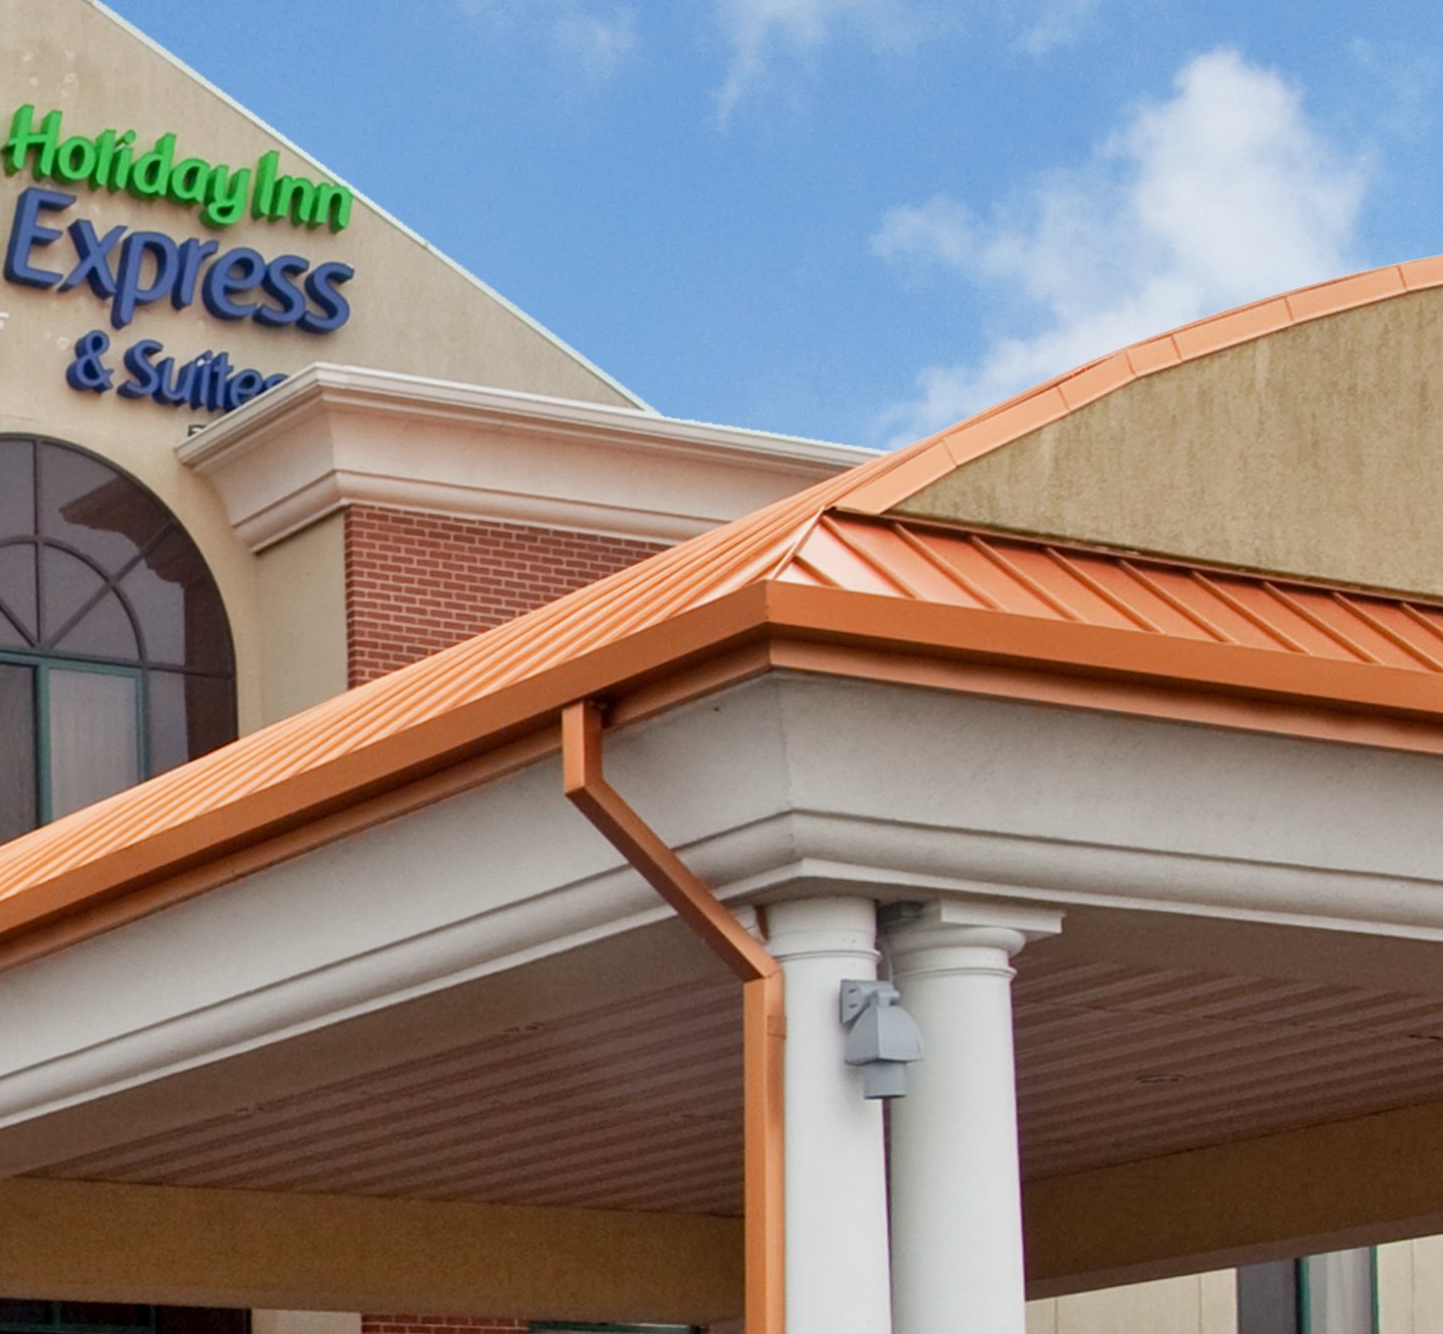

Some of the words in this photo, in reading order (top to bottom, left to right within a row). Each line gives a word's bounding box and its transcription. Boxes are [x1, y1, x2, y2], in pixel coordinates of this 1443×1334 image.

[0, 103, 251, 232] Holiday
[251, 150, 354, 234] Inn
[3, 186, 354, 334] Express
[66, 330, 114, 394] &
